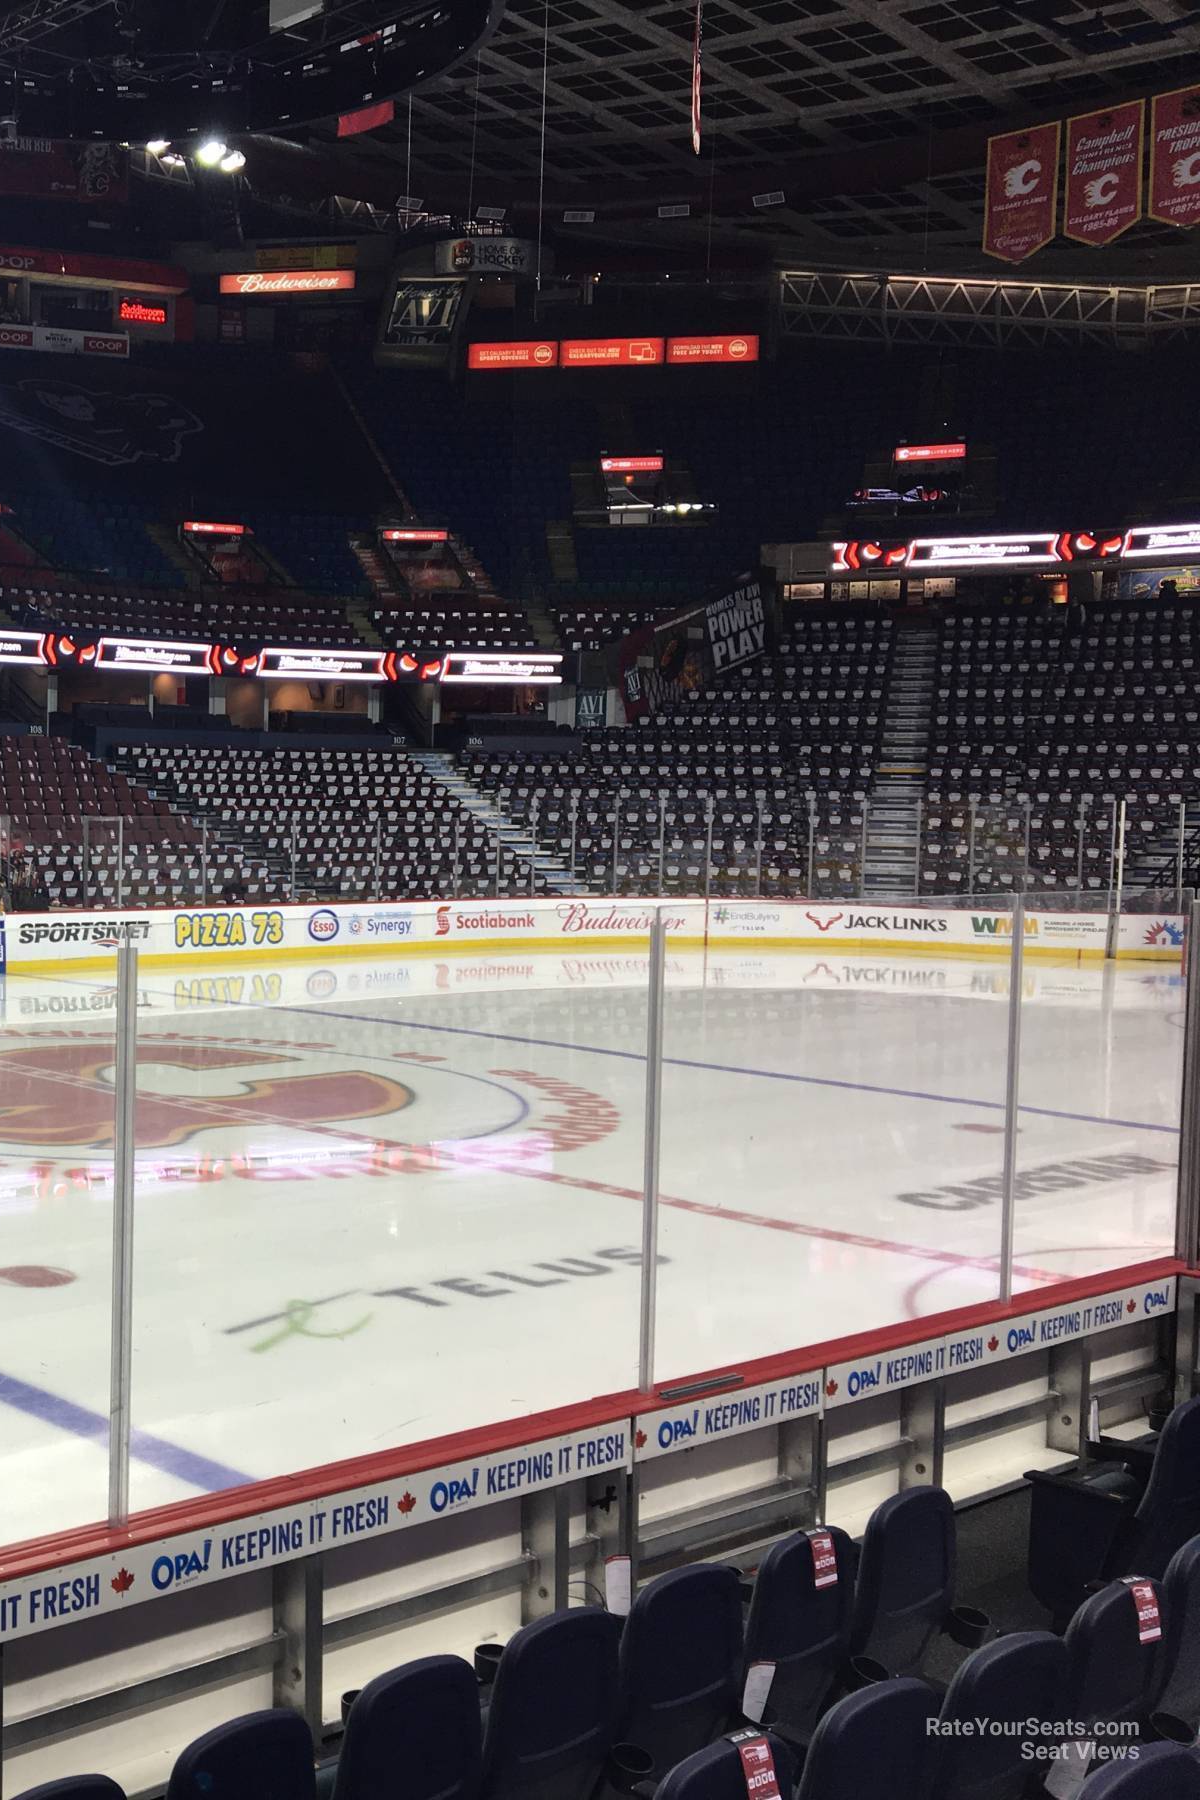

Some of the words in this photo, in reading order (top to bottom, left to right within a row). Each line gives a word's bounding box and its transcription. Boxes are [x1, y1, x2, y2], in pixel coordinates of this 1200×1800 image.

[1075, 124, 1136, 153] Campbell
[1071, 152, 1136, 176] Champions
[236, 273, 340, 293] Budweiser
[707, 598, 765, 642] POWER
[711, 622, 766, 672] PLAY
[577, 695, 604, 715] AVI
[29, 724, 43, 734] 108
[393, 736, 406, 745] 107
[468, 737, 483, 745] 106
[174, 912, 247, 948] PIZZA
[251, 910, 284, 945] 73
[313, 919, 335, 933] Esso
[367, 918, 412, 936] Synergy
[456, 912, 535, 929] Scotiabank
[555, 902, 686, 932] Budweiser
[844, 914, 891, 930] JACK
[18, 921, 151, 944] SPORTSNET
[371, 1245, 673, 1307] TELUS
[1143, 1284, 1171, 1314] OPA!
[1006, 1320, 1038, 1353] OPA!
[1040, 1312, 1080, 1342] KEEPING
[1081, 1307, 1093, 1331] IT
[1094, 1300, 1124, 1327] FRESH
[846, 1361, 881, 1398] OPA!
[885, 1351, 933, 1386] KEEPING
[934, 1347, 946, 1370] IT
[949, 1337, 984, 1368] FRESH
[657, 1407, 701, 1449] OPA!
[704, 1395, 761, 1435] KEEPING
[764, 1390, 777, 1416] IT
[779, 1379, 821, 1412] FRESH
[430, 1467, 479, 1513] OPA!
[486, 1451, 554, 1496] KEEPING
[558, 1445, 572, 1474] IT
[576, 1432, 625, 1470] FRESH
[151, 1538, 213, 1591] OPA!
[220, 1519, 303, 1570] KEEPING
[308, 1513, 327, 1543] IT
[331, 1495, 390, 1537] FRESH
[0, 1594, 23, 1632] IT
[29, 1572, 101, 1624] FRESH
